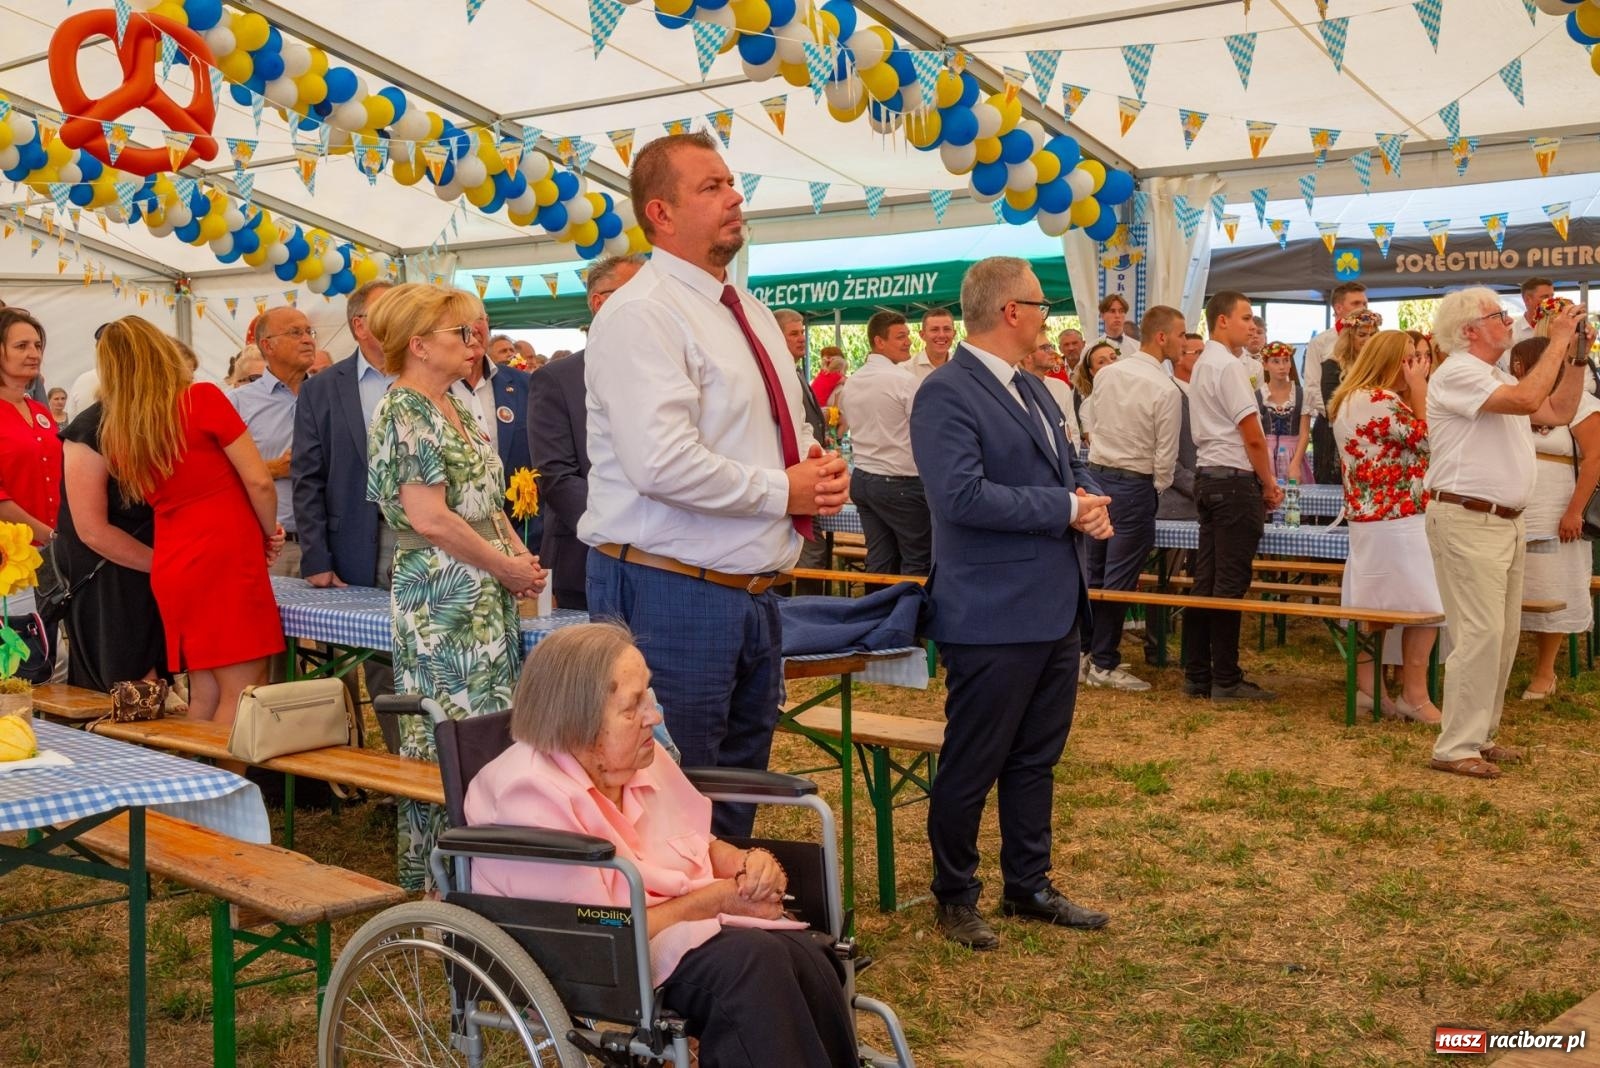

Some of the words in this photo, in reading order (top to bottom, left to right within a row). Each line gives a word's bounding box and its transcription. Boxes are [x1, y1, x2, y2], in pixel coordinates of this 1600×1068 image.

[1395, 249, 1520, 273] SOŁECTWO
[747, 280, 840, 306] OŁECTWO
[842, 272, 939, 300] ŻERDZINY
[577, 907, 632, 925] Mobility
